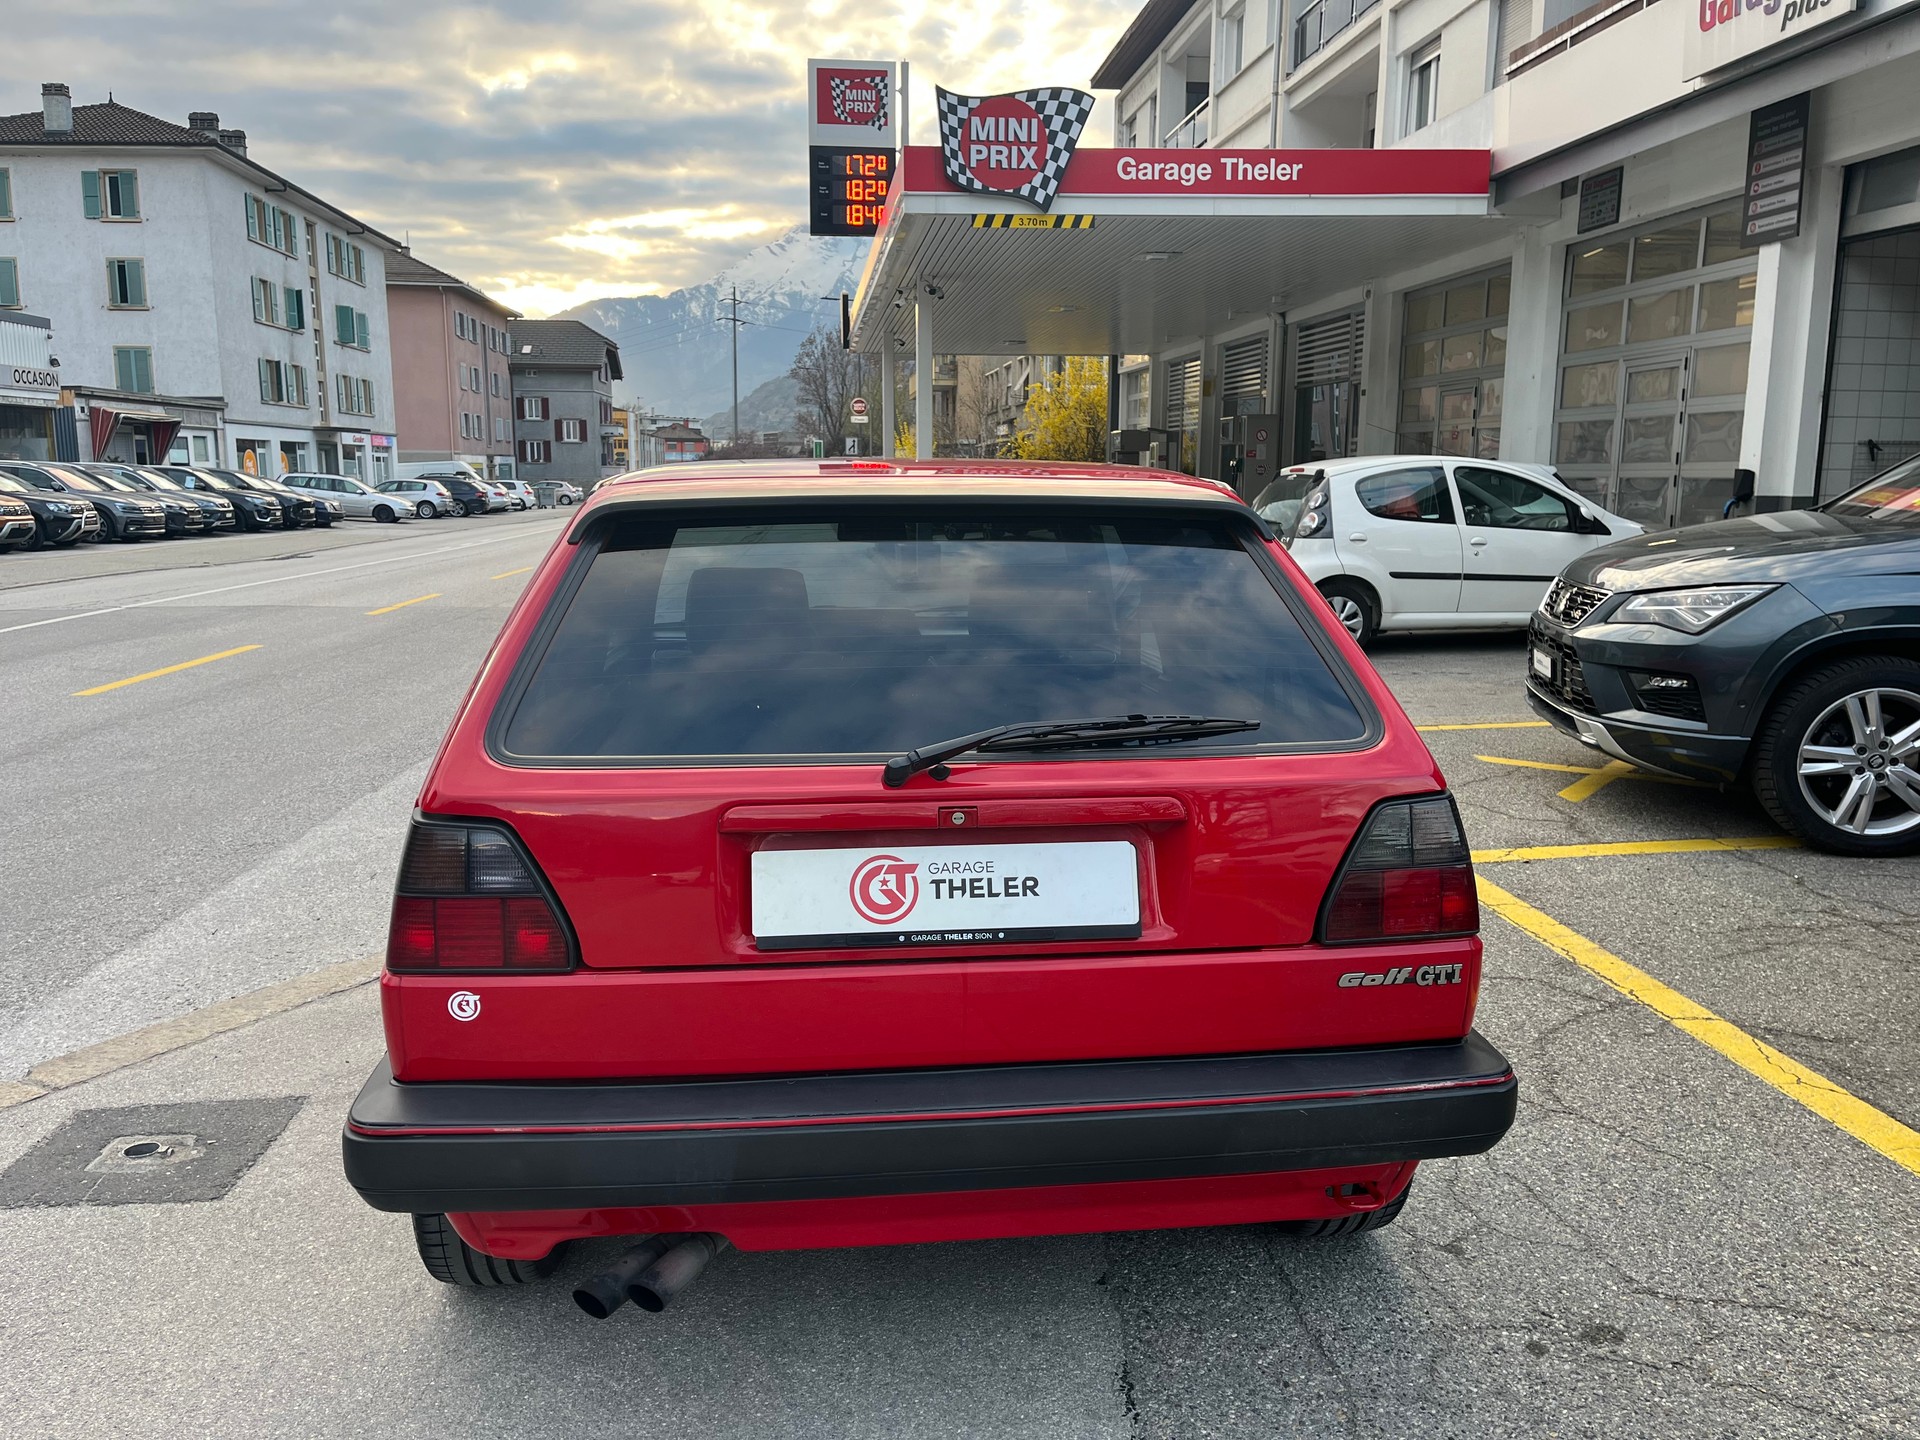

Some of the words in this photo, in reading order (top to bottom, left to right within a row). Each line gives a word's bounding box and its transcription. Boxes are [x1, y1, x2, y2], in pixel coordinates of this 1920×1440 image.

[845, 89, 876, 101] MINI
[845, 101, 877, 113] PRIX
[970, 116, 1038, 142] MINI
[970, 144, 1038, 170] PRIX
[1116, 156, 1212, 186] Garage
[1220, 157, 1303, 181] Theler
[13, 369, 59, 387] OCCASION
[928, 861, 995, 875] GARAGE
[929, 876, 1040, 899] THELER
[911, 934, 941, 942] GARAGE
[944, 933, 973, 941] THELER
[974, 932, 993, 940] SION
[1338, 967, 1413, 988] Golf
[1416, 963, 1463, 986] GTI
